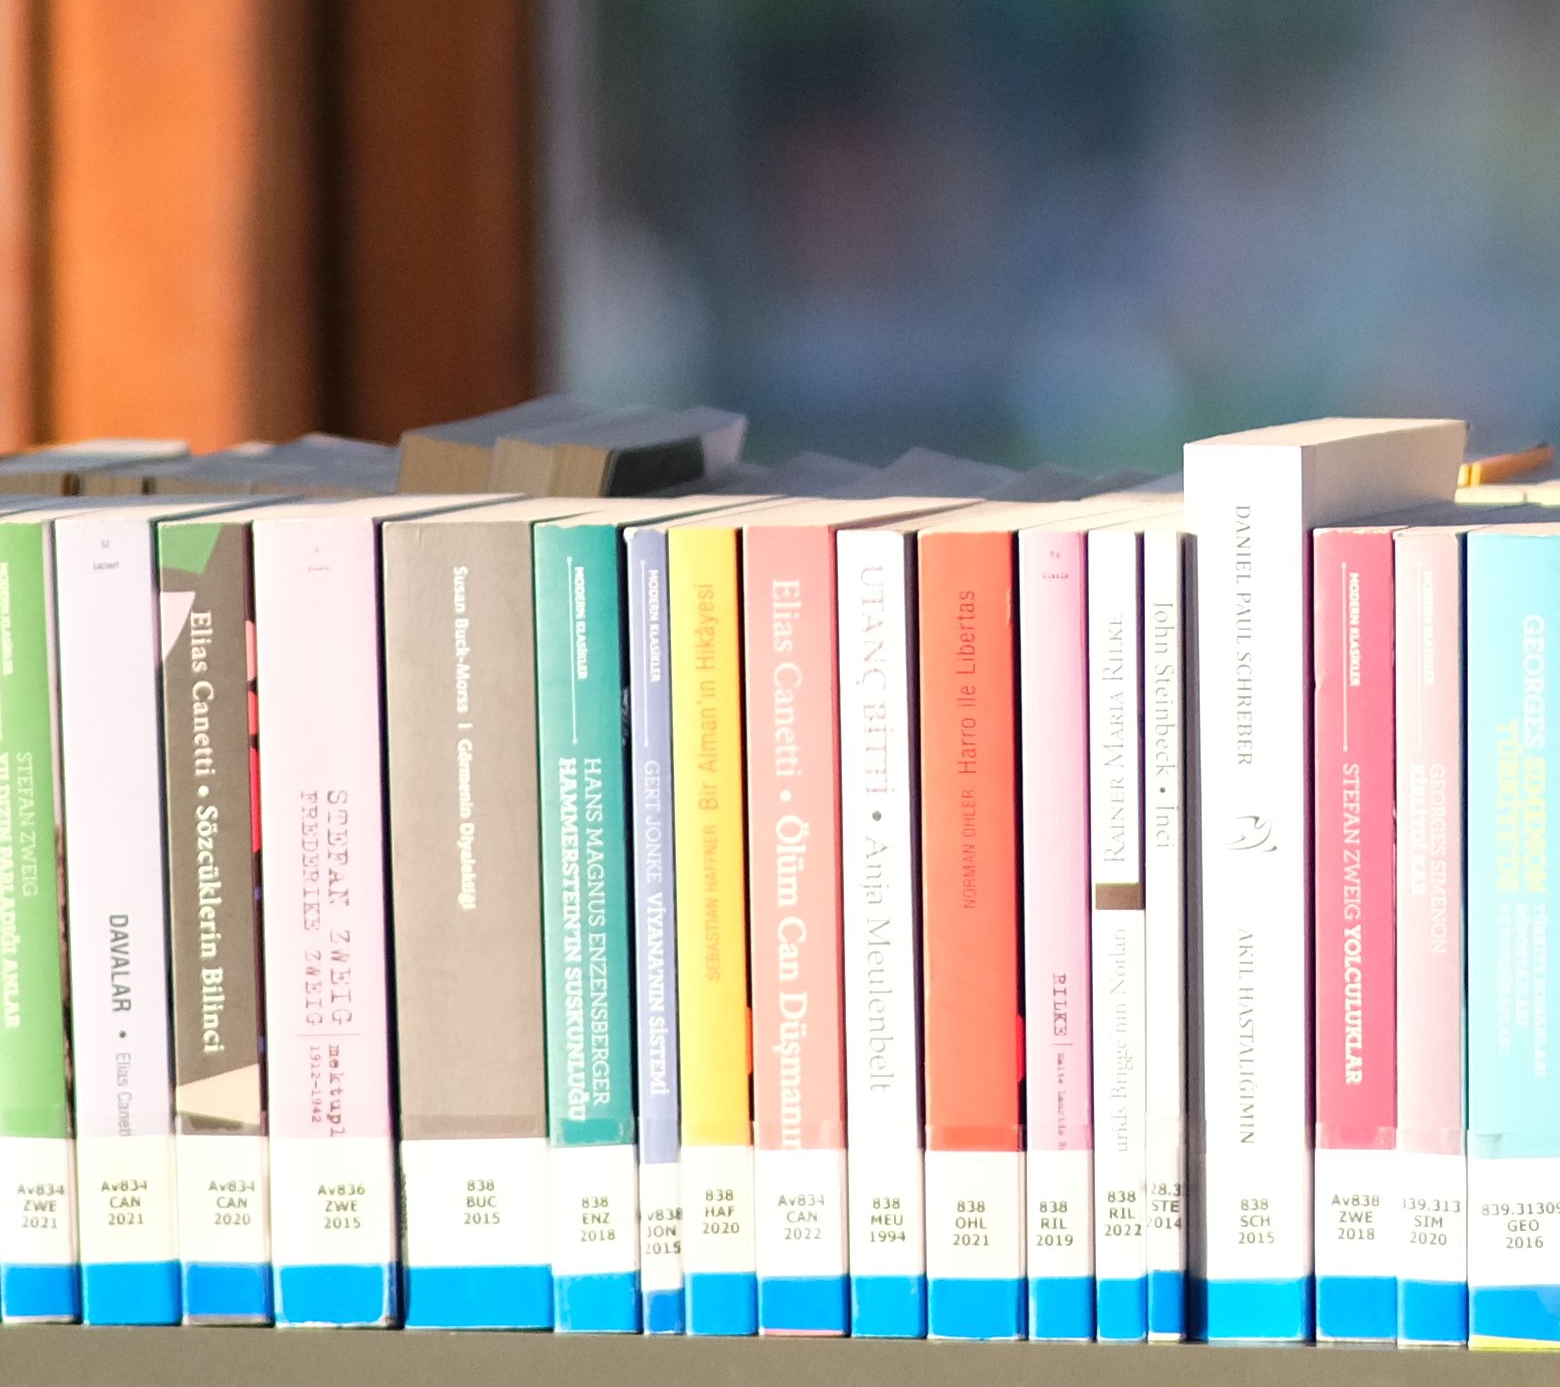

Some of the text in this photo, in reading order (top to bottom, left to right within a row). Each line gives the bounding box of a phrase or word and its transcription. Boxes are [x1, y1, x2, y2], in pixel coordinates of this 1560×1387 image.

[770, 578, 809, 981] Elias Canetti Ölüm Can
[643, 761, 662, 812] GERT
[642, 817, 664, 884] JONKE
[1342, 763, 1363, 1085] STEFAN ZWEIG YOLCULUKLAR
[107, 914, 131, 1013] DAVALAR
[648, 1017, 670, 1096] SİSTEMİ
[317, 1182, 365, 1196] Av836
[466, 1179, 495, 1192] 838
[466, 1195, 497, 1208] BUC
[704, 1189, 734, 1202] 838
[325, 1199, 359, 1212] ZWE
[704, 1205, 735, 1218] HAF
[323, 1216, 361, 1229] 2015
[463, 1212, 501, 1225] 2015
[702, 1222, 740, 1235] 2020
[1507, 1220, 1540, 1233] GEO
[1505, 1236, 1544, 1250] 2016
